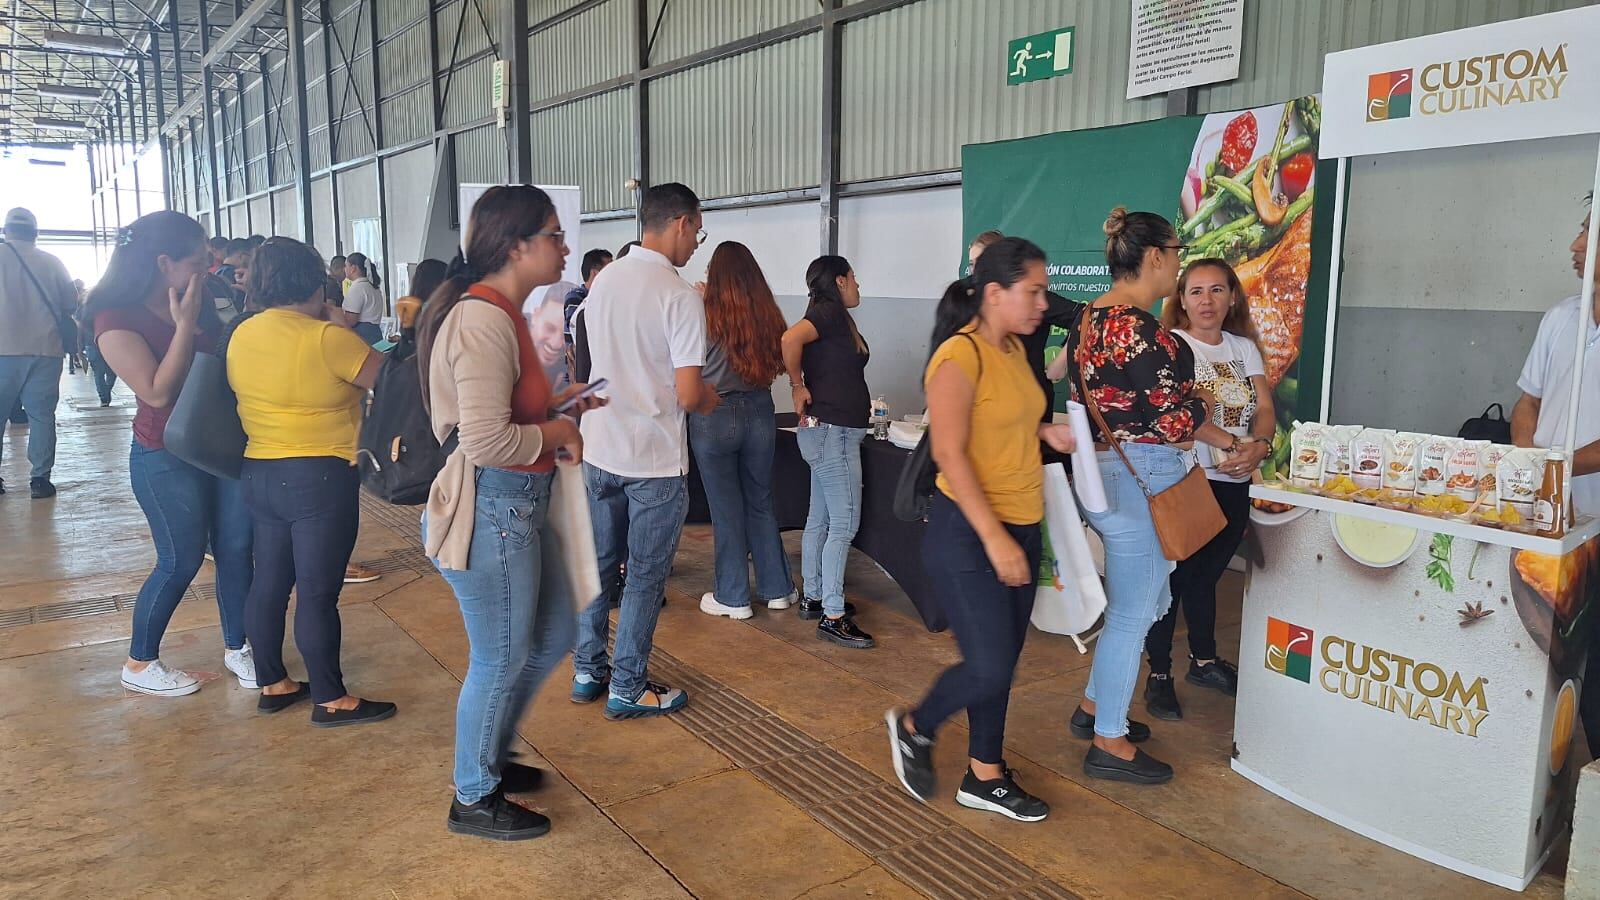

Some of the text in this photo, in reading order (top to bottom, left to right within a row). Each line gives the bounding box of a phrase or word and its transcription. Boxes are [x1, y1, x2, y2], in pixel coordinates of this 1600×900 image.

[1172, 24, 1196, 33] GENERAL
[1419, 43, 1568, 92] CUSTOM
[1419, 73, 1568, 116] CULINARY
[1048, 281, 1077, 291] vivimos
[1320, 635, 1489, 712] CUSTOM
[1319, 666, 1489, 738] CULINARY
